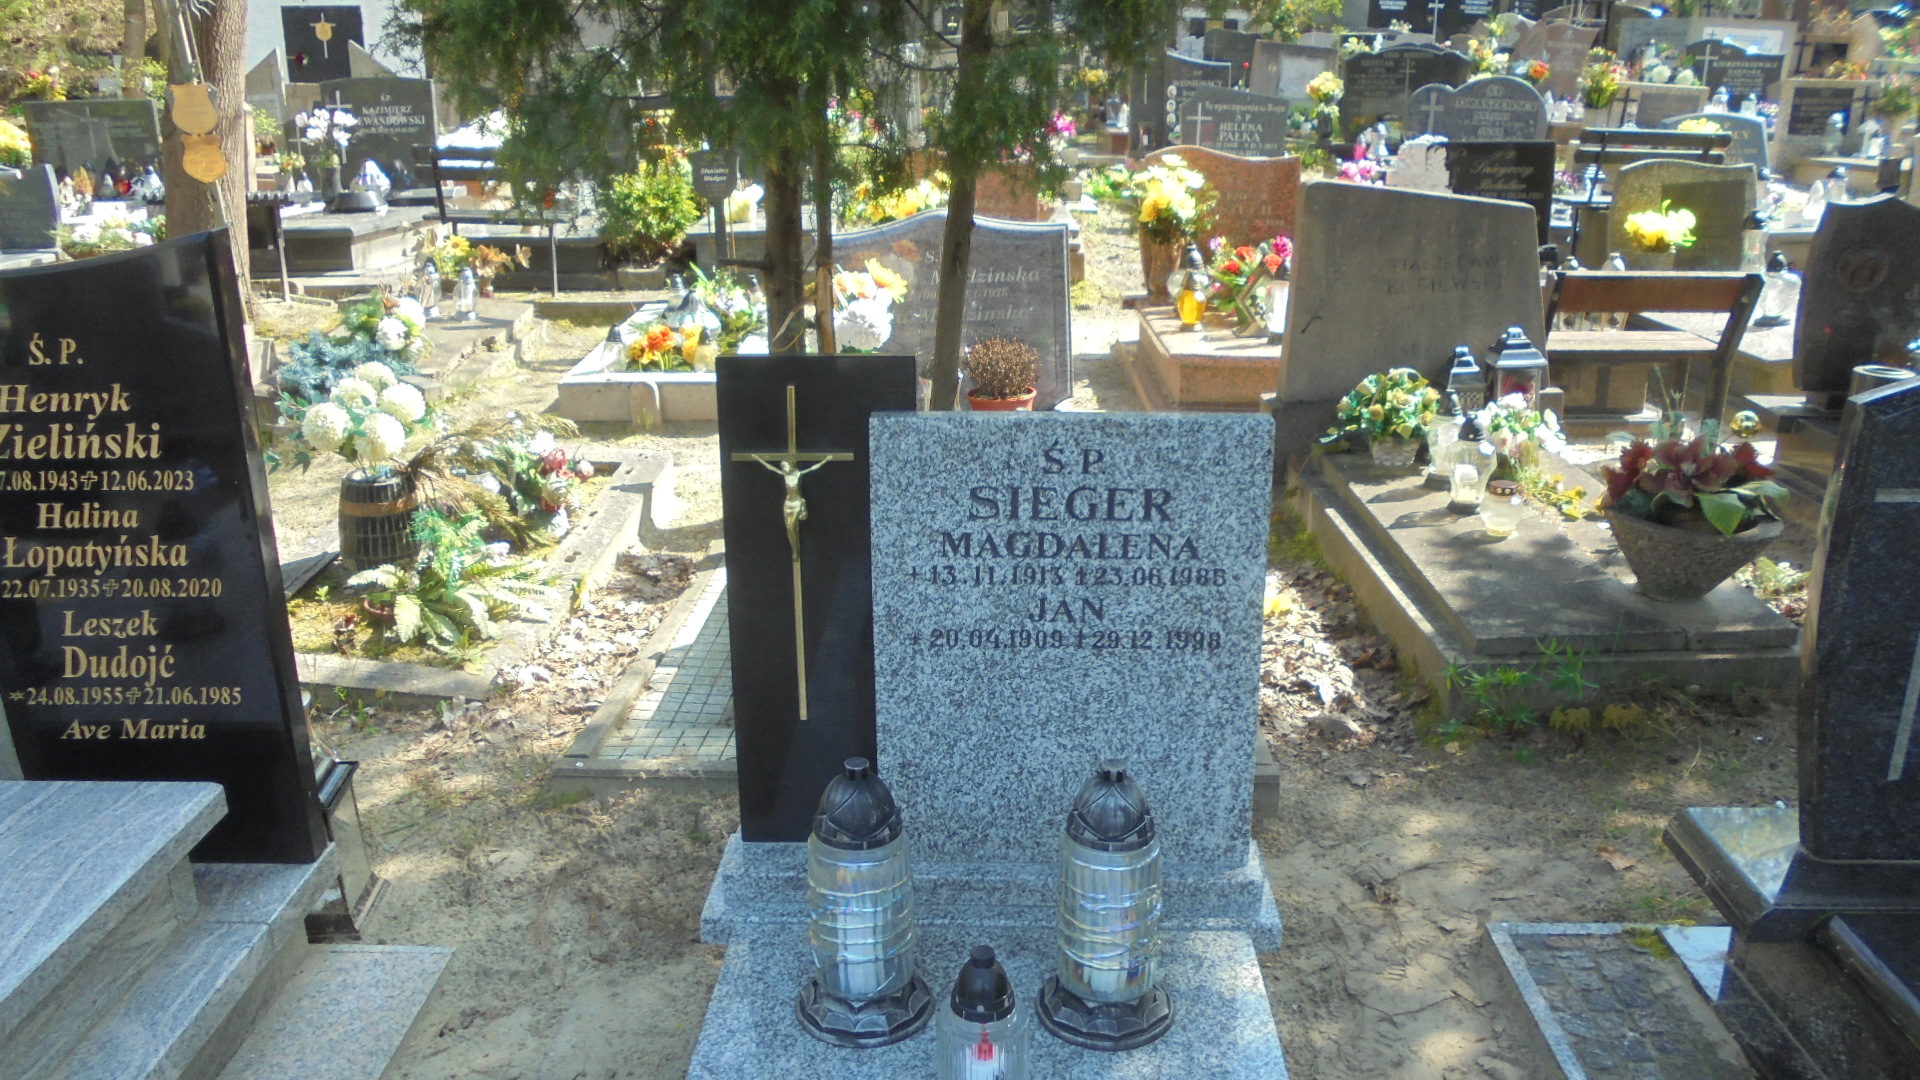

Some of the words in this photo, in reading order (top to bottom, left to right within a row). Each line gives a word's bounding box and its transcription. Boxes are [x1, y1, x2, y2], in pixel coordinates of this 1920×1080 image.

[357, 115, 425, 125] EWANDOWSKI
[362, 105, 414, 114] KAZIMIERZ
[1220, 122, 1263, 132] HELENA
[0, 383, 131, 420] Henryk
[101, 470, 194, 491] 12.06.2023
[36, 502, 140, 529] Halina
[968, 486, 1172, 522] SIEGER
[3, 534, 189, 577] Łopatyńska
[941, 532, 1200, 560] MAGDALENA
[61, 609, 158, 638] Leszek
[1029, 597, 1104, 623] JAN
[61, 645, 175, 687] Dudojć
[60, 718, 112, 740] Ave
[120, 717, 207, 740] Maria
